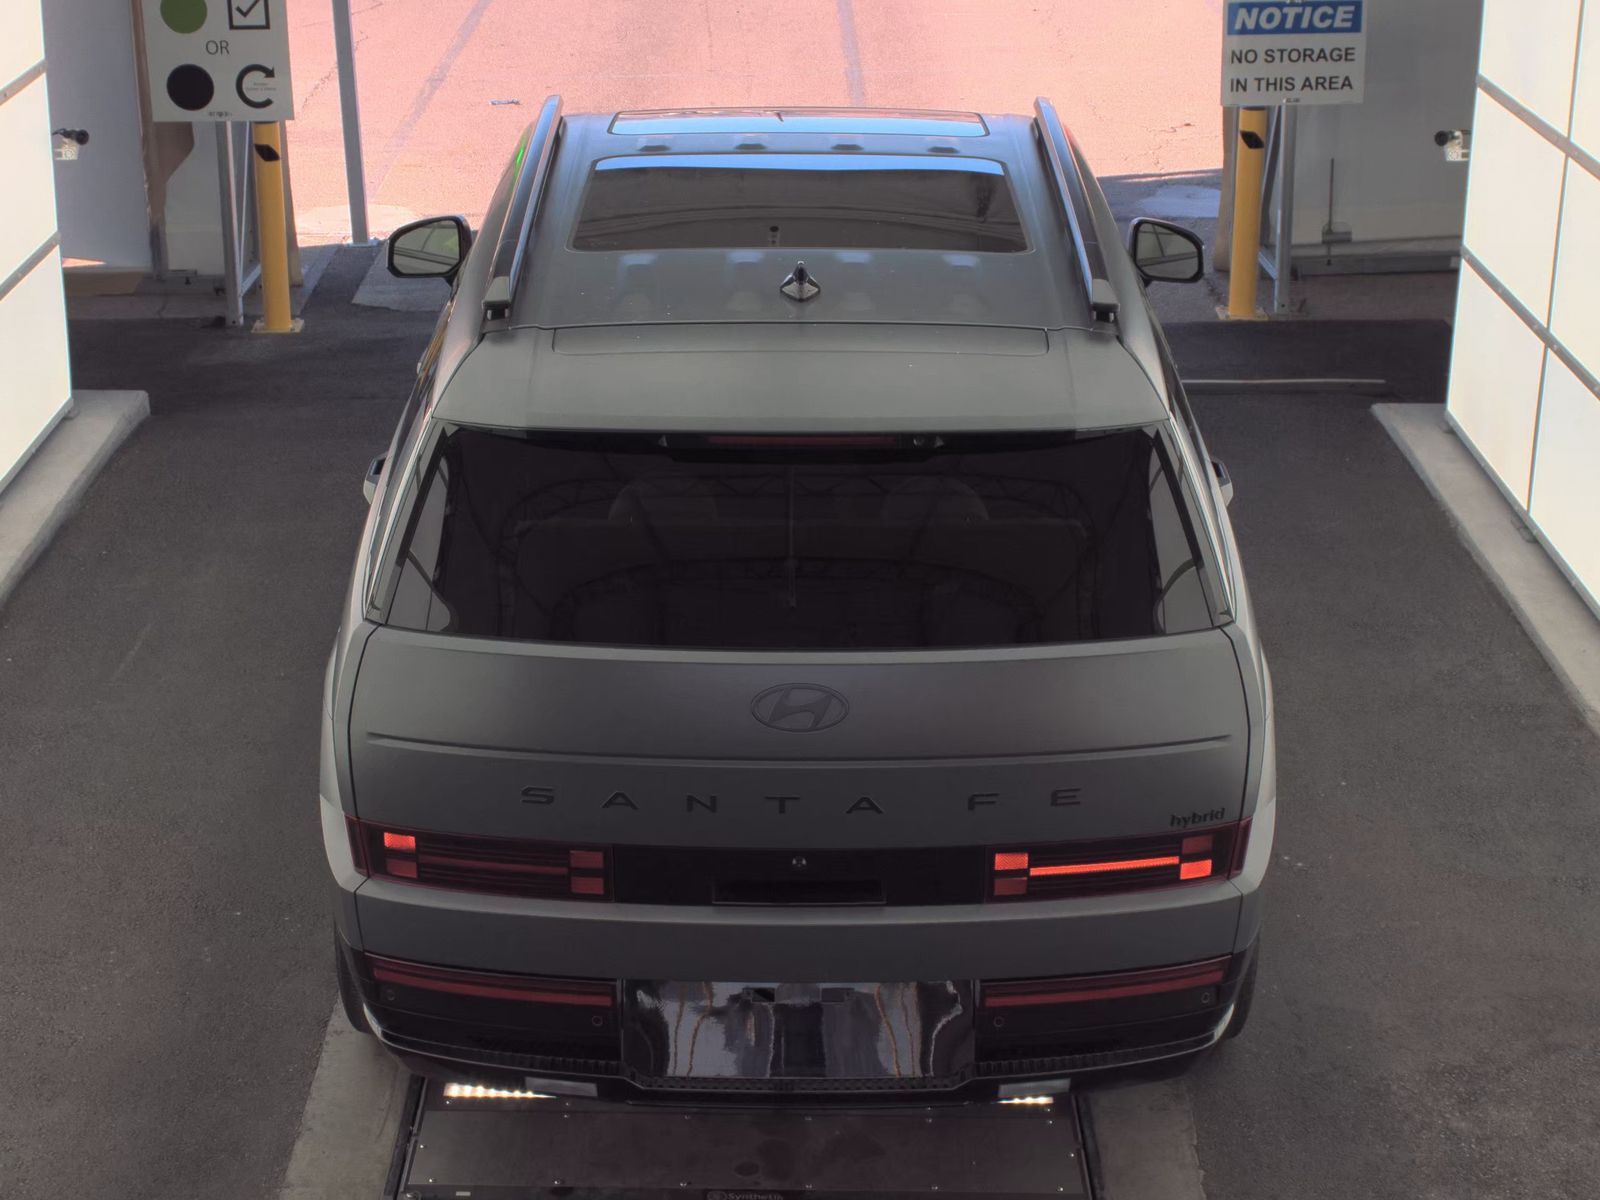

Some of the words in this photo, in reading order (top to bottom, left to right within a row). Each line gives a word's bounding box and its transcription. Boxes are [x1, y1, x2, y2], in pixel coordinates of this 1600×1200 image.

[1234, 6, 1355, 30] NOTICE
[205, 39, 230, 55] OR
[1231, 49, 1258, 64] NO
[1264, 47, 1356, 63] STORAGE
[1230, 78, 1248, 92] IN
[1254, 77, 1296, 92] THIS
[1301, 76, 1353, 91] AREA
[520, 785, 884, 815] SANTA
[967, 788, 1082, 812] FE
[1167, 807, 1226, 828] hybrid
